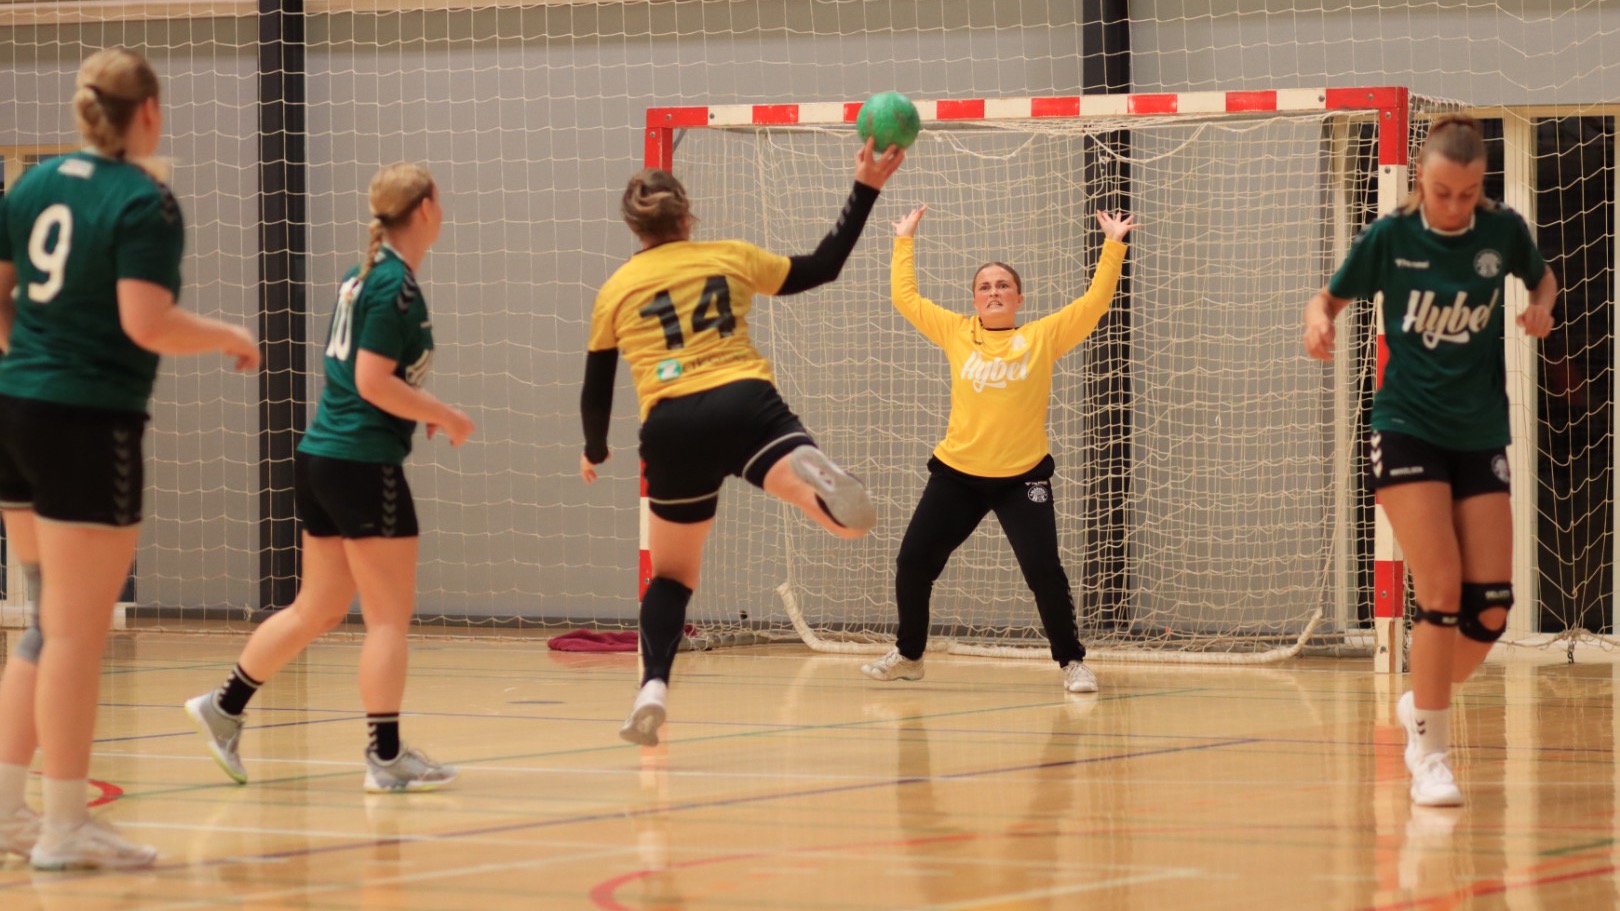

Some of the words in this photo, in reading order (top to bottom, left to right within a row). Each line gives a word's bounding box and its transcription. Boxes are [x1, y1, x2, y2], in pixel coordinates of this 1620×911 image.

[28, 203, 73, 303] 9
[326, 276, 364, 361] 10
[638, 275, 736, 350] 14
[1401, 287, 1499, 349] Hybel
[961, 350, 1030, 393] Hybel
